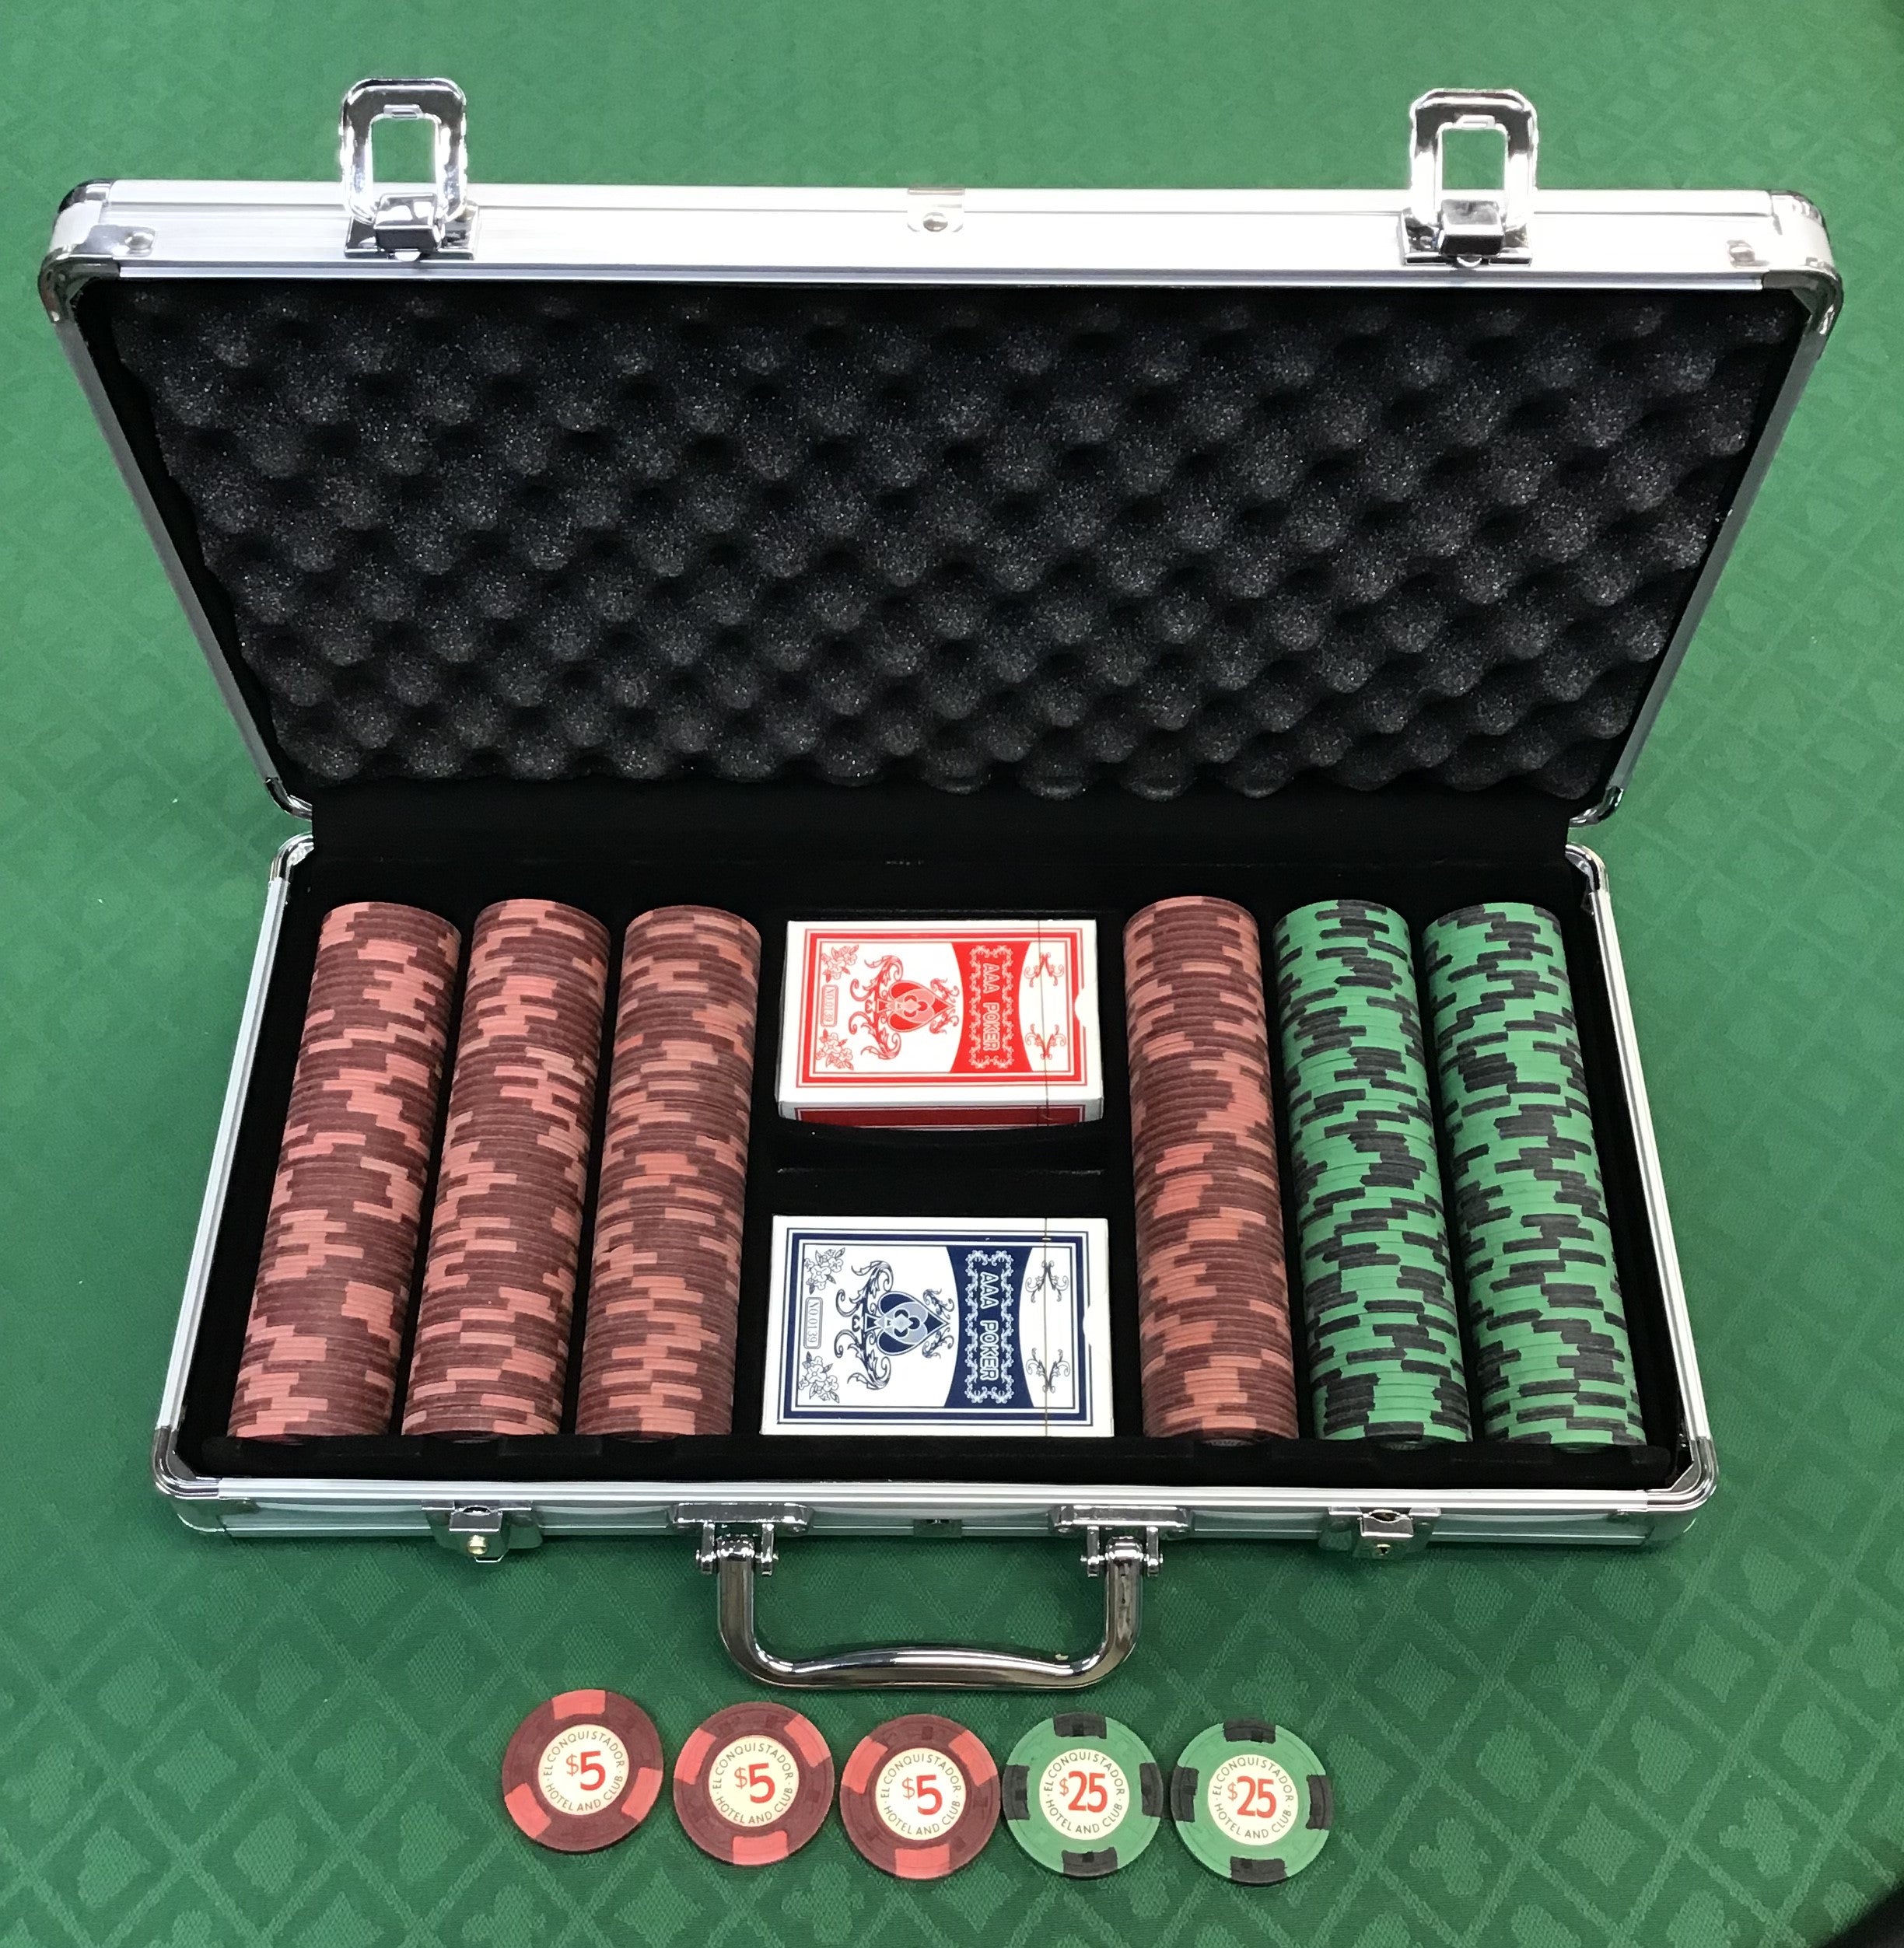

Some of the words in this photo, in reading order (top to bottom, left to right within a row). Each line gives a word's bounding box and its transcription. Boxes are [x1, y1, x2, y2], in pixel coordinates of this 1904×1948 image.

[982, 963, 1000, 994] AAA
[982, 1002, 1000, 1051] POKER
[980, 1271, 999, 1310] AAA
[980, 1320, 999, 1381] POKER
[566, 1750, 605, 1791] $5
[734, 1763, 775, 1803] $5
[545, 1783, 573, 1810] HOTEL
[576, 1799, 600, 1811] AND
[604, 1776, 623, 1800] CLUB
[716, 1796, 744, 1824] HOTEL
[748, 1811, 772, 1824] AND
[775, 1788, 793, 1812] CLUB
[902, 1775, 943, 1815] $5
[1059, 1771, 1108, 1813] $25
[1227, 1776, 1276, 1818] $25
[884, 1806, 912, 1834] HOTEL
[916, 1824, 940, 1835] AND
[942, 1800, 960, 1825] CLUB
[1046, 1799, 1071, 1831] HOTEL
[1076, 1824, 1099, 1834] AND
[1102, 1803, 1122, 1827] CLUB
[1215, 1803, 1241, 1835] HOTEL
[1244, 1829, 1269, 1838] AND
[1272, 1810, 1291, 1833] CLUB
